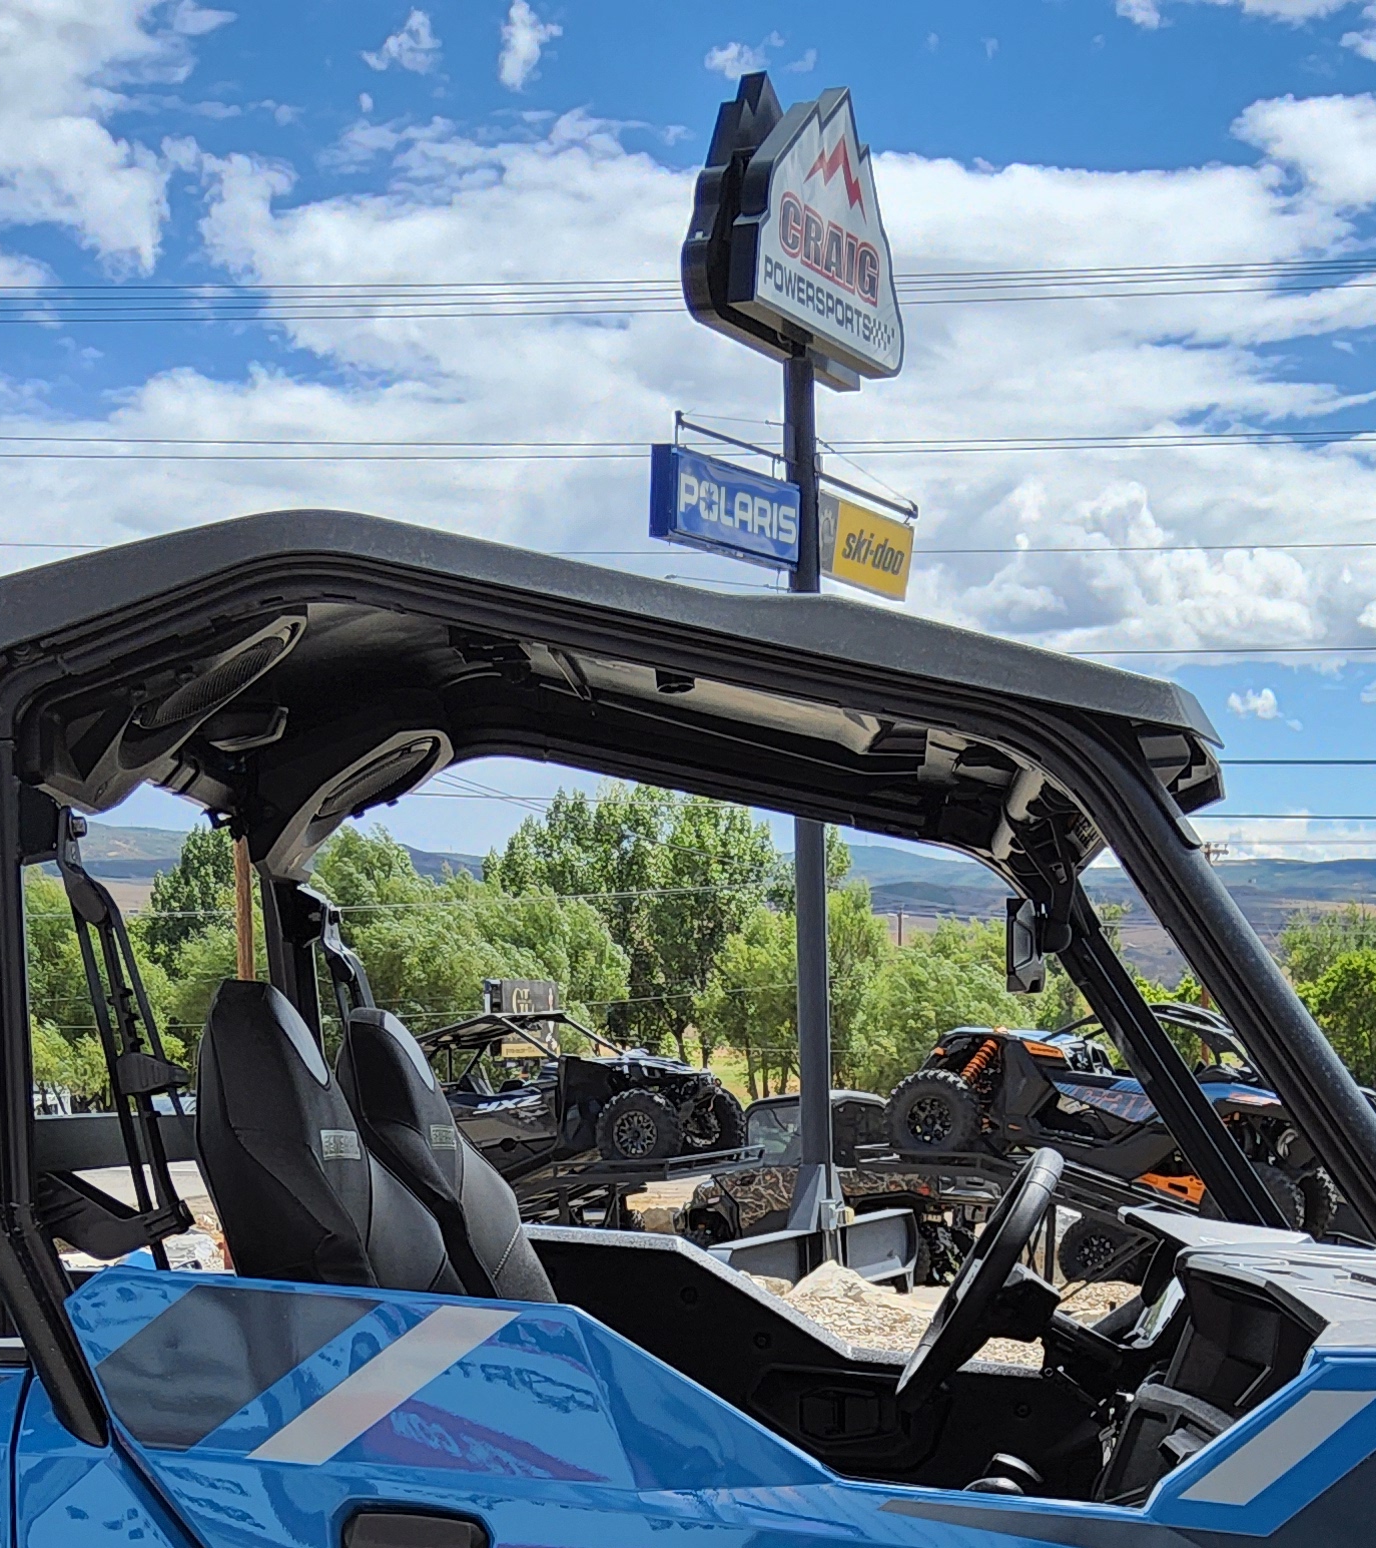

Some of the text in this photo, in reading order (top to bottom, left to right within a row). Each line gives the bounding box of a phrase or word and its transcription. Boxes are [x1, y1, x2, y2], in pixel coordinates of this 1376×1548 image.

[779, 191, 880, 308] CRAIG
[764, 254, 872, 342] POWERSPORTS
[679, 473, 798, 545] POLARIS
